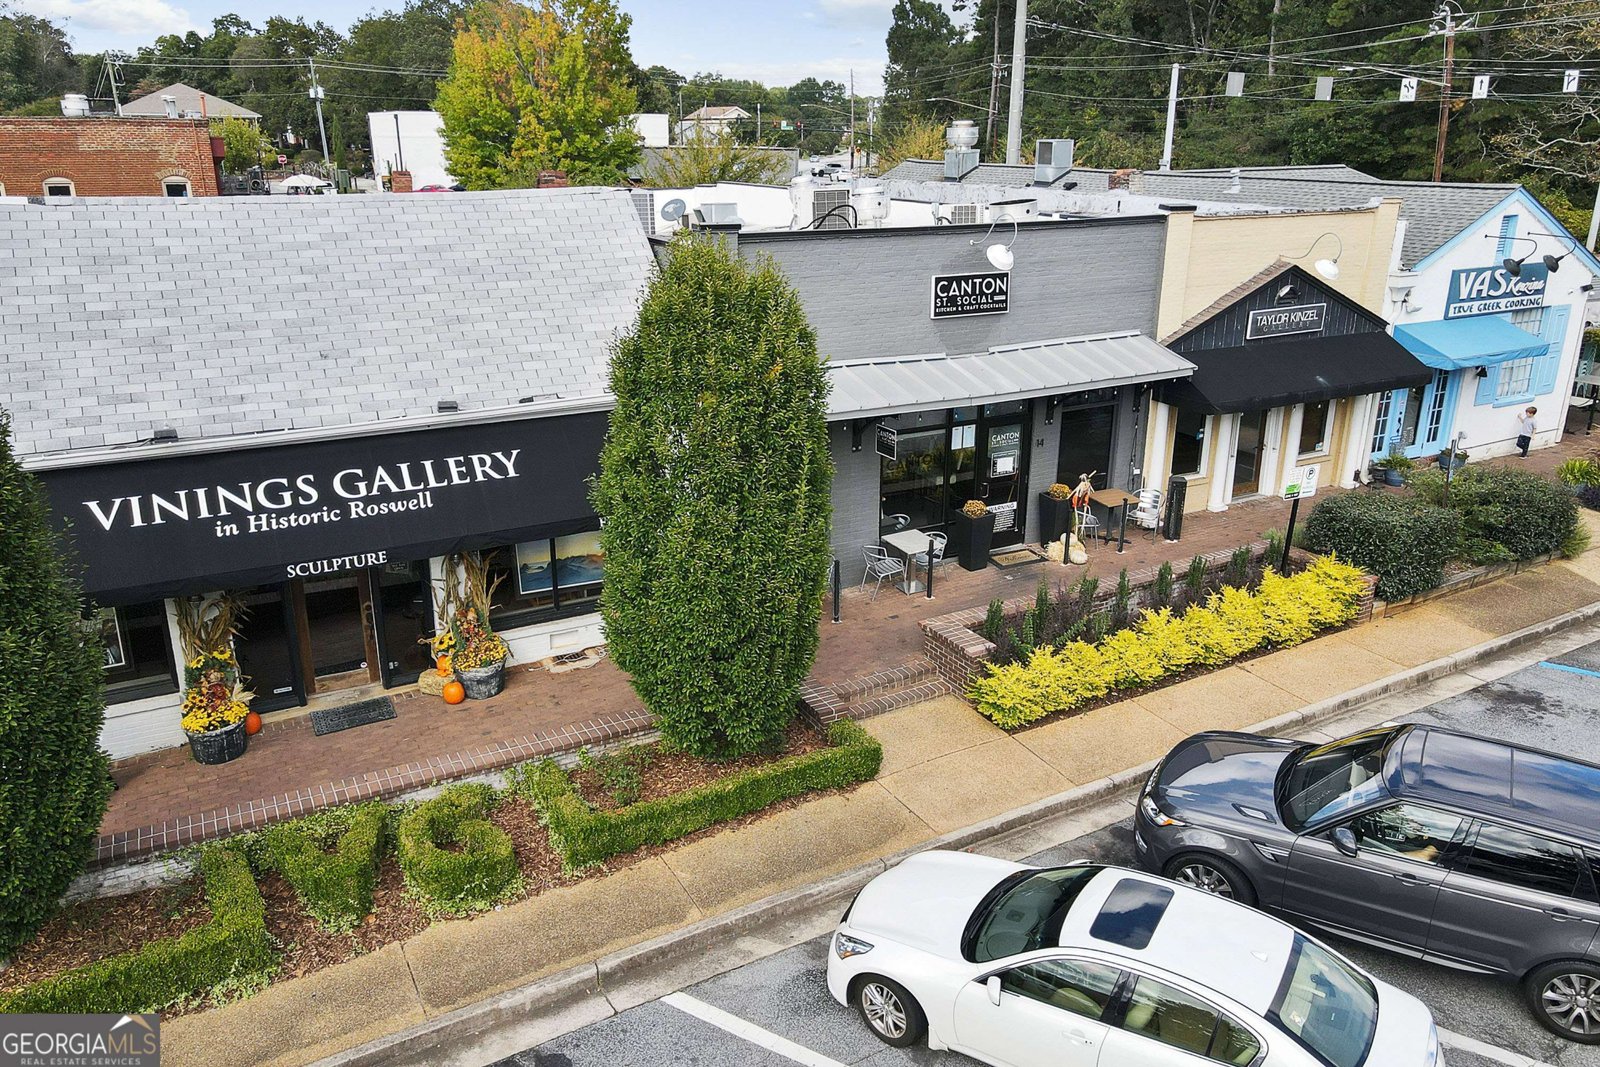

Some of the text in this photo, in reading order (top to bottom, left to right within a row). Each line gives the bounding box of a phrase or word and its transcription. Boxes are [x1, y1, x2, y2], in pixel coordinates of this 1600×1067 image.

[936, 276, 1007, 297] CANTON
[1459, 269, 1507, 299] VAS
[936, 294, 993, 307] ST. SOCIAL
[1453, 297, 1541, 315] TRUE GREEK COOKING
[1256, 309, 1319, 327] TAYLOR KINZEL
[991, 431, 1020, 442] CANTON
[1036, 438, 1045, 448] 14
[85, 449, 521, 531] VININGS GALLERY
[214, 491, 434, 538] in Historic Roswell
[286, 550, 388, 578] SCULPTURE
